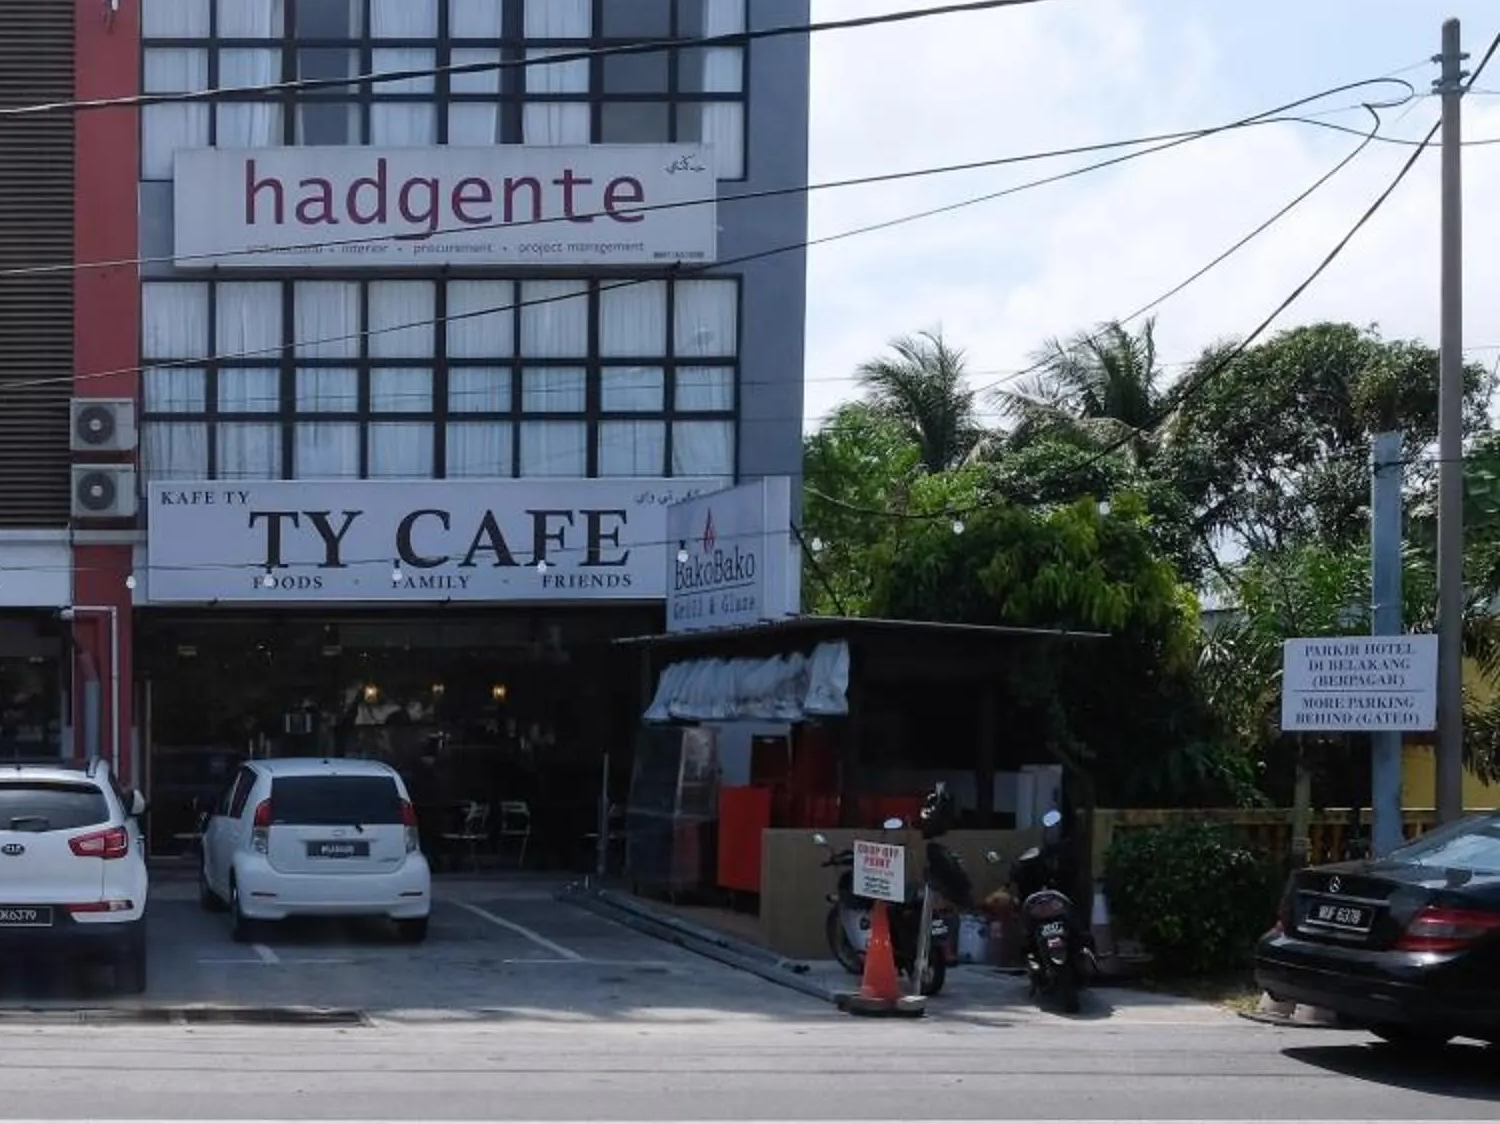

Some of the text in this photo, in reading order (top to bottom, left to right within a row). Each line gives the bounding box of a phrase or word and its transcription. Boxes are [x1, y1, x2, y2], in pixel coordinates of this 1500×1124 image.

[245, 158, 646, 240] hadgente
[518, 242, 563, 256] project
[567, 242, 645, 254] management
[161, 491, 250, 506] KAFE TY
[249, 508, 630, 568] TY CAFE
[674, 545, 756, 591] BakoBako
[542, 575, 632, 589] FRIENDS
[1305, 643, 1416, 657] PARKIR HOTEL
[1308, 659, 1411, 672] DI BELAKANG
[1301, 696, 1415, 709] MORE PARKING
[1295, 711, 1419, 725] BEHIND (GATED)
